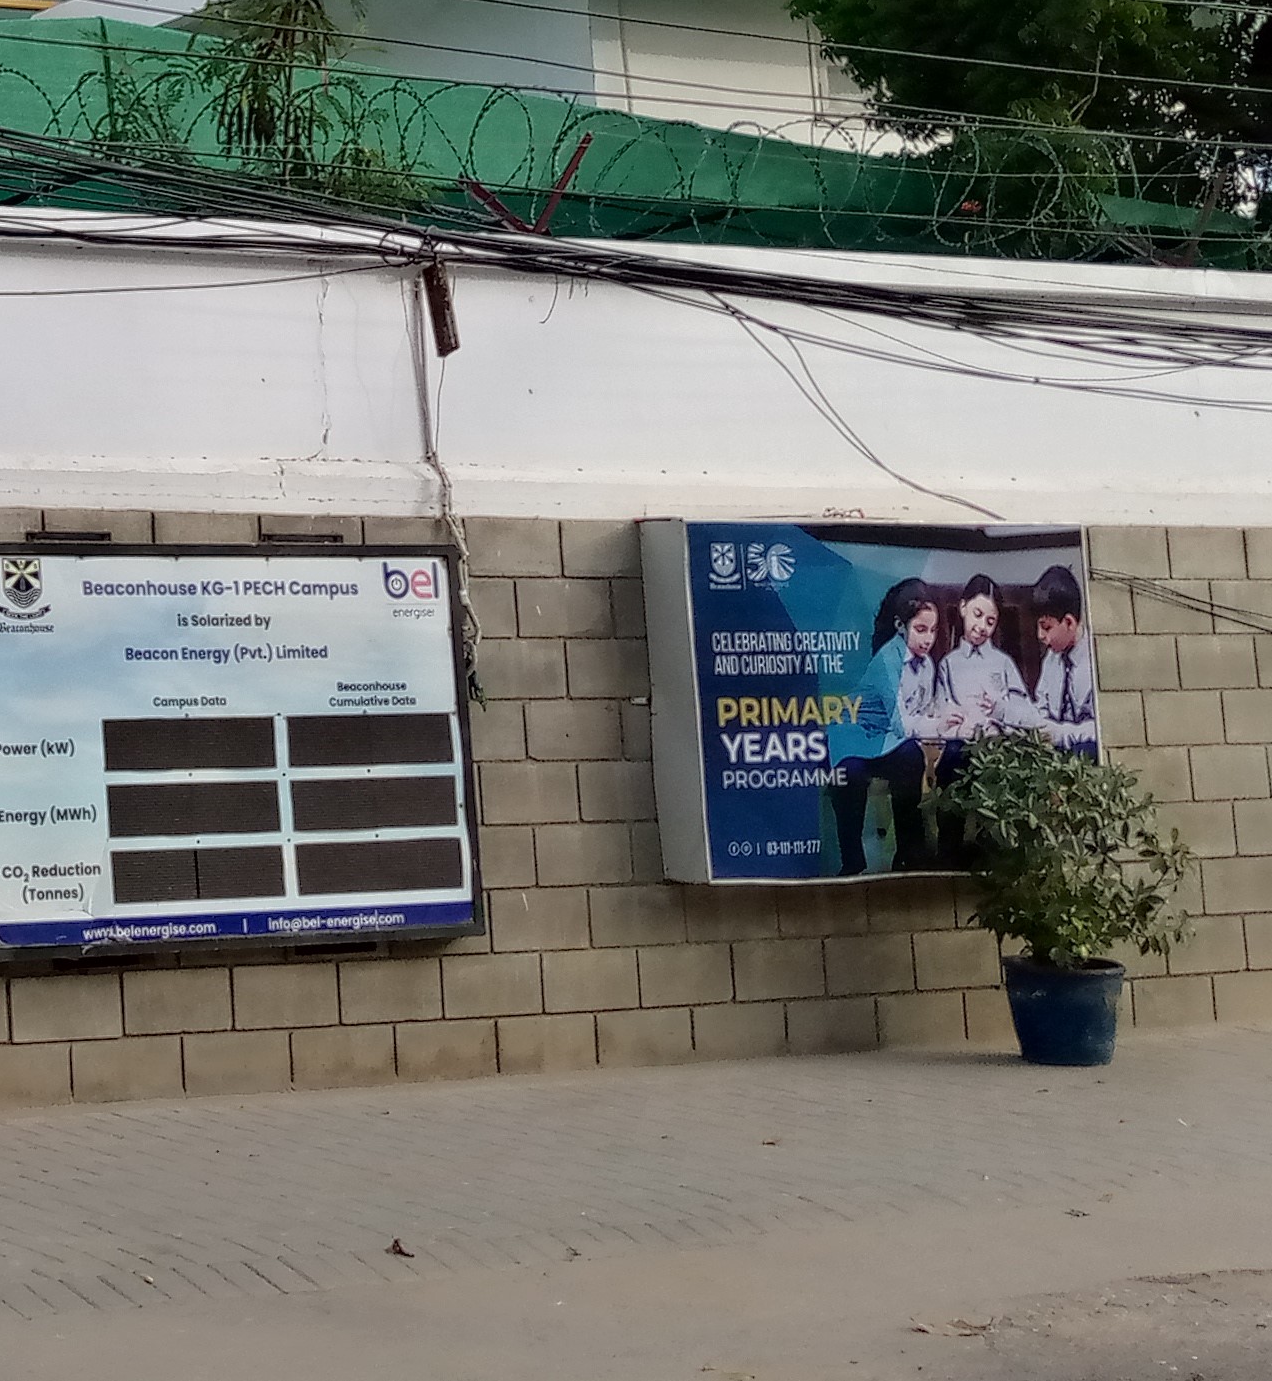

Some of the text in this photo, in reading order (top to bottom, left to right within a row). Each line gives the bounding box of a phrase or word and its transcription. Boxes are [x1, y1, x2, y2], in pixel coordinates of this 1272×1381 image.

[382, 561, 439, 599] bel
[82, 580, 359, 601] Beaconhouse KG-1 PECH Campus
[177, 613, 271, 630] is Solarized by
[712, 631, 861, 652] CELEBRATING CREATIVITY
[125, 643, 329, 664] Beacon Energy (Pvt.) Limited
[714, 653, 845, 675] AND CURIOSITY AT THE
[336, 680, 408, 693] Beaconhouse
[152, 696, 227, 710] Campus Data
[328, 694, 417, 708] Cumulative Data
[716, 695, 863, 728] PRIMARY
[40, 738, 75, 758] (kW)
[719, 732, 828, 764] YEARS
[722, 767, 849, 790] PROGRAMME
[50, 804, 98, 824] (MWh)
[32, 863, 102, 877] Reduction
[22, 884, 84, 904] (Tonnes)
